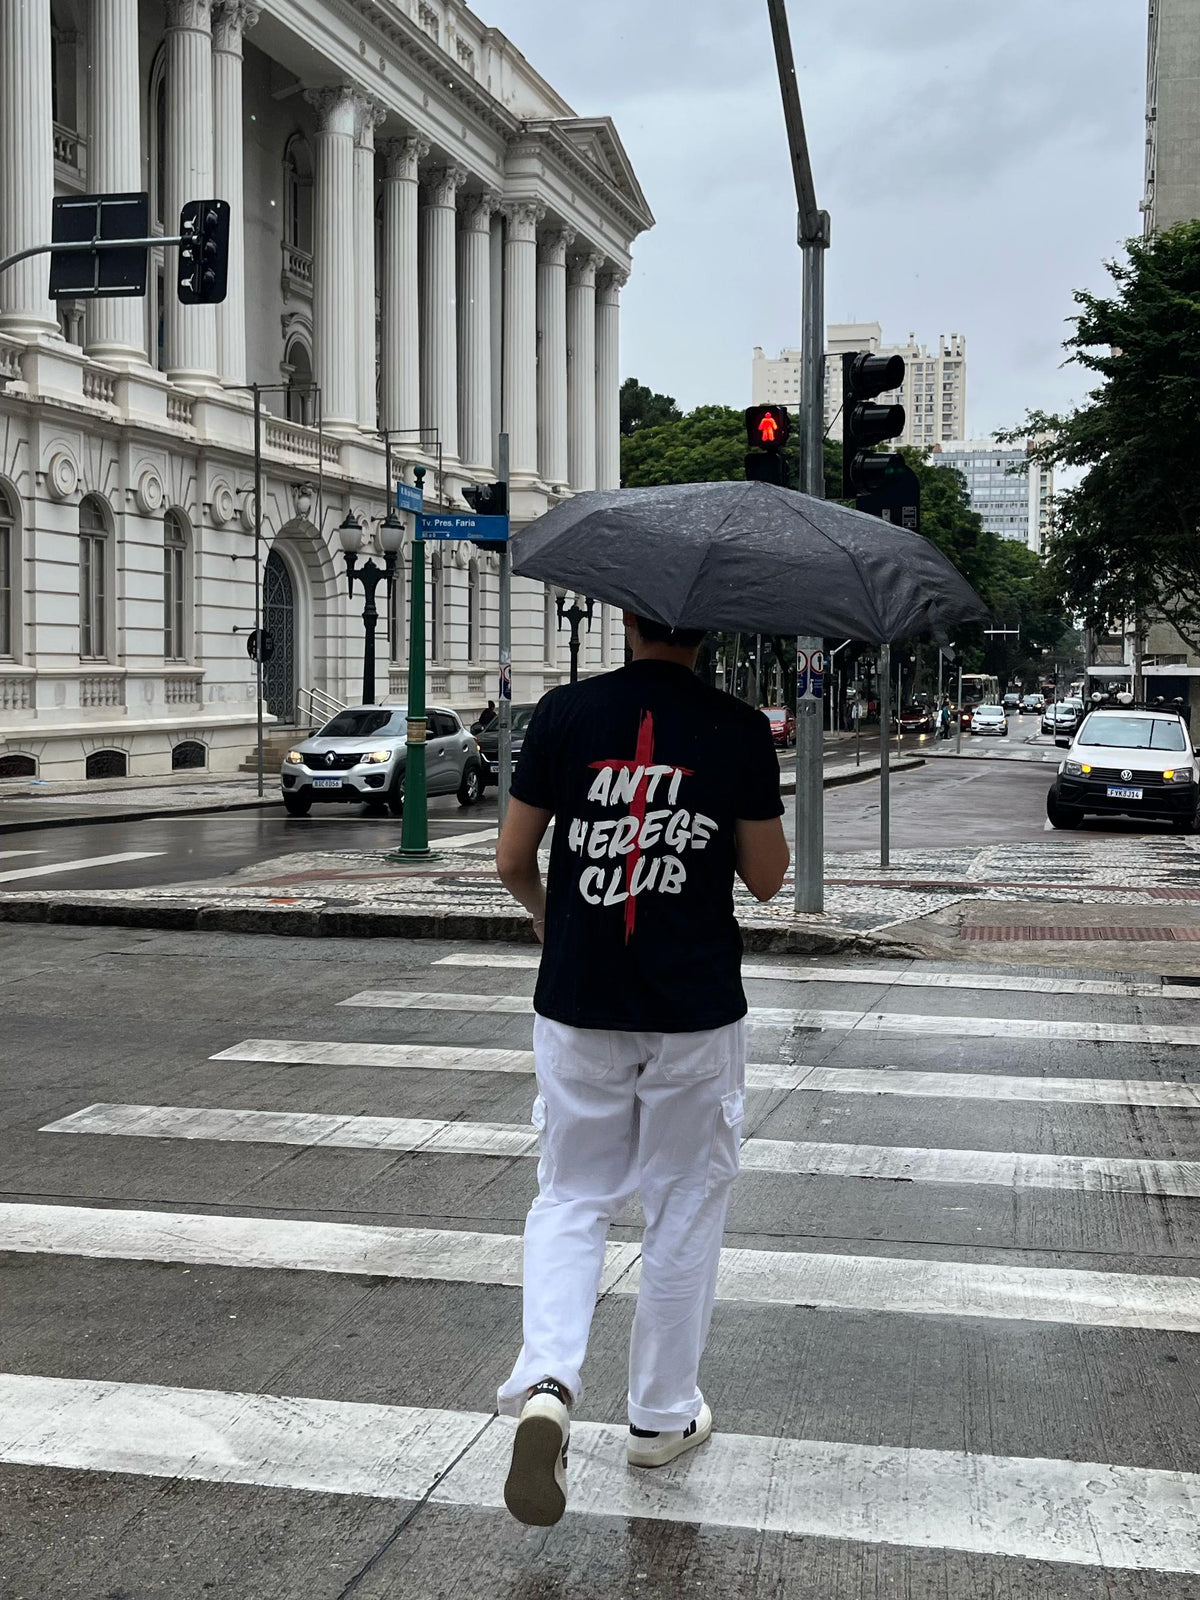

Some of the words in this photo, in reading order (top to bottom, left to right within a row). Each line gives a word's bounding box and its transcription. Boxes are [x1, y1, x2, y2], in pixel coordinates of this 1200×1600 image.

[421, 519, 432, 527] Tv.
[434, 519, 454, 527] Pres.
[455, 519, 476, 527] Faria
[587, 765, 683, 807] ANTI
[579, 855, 687, 906] CLUB
[536, 1383, 560, 1392] VEJA
